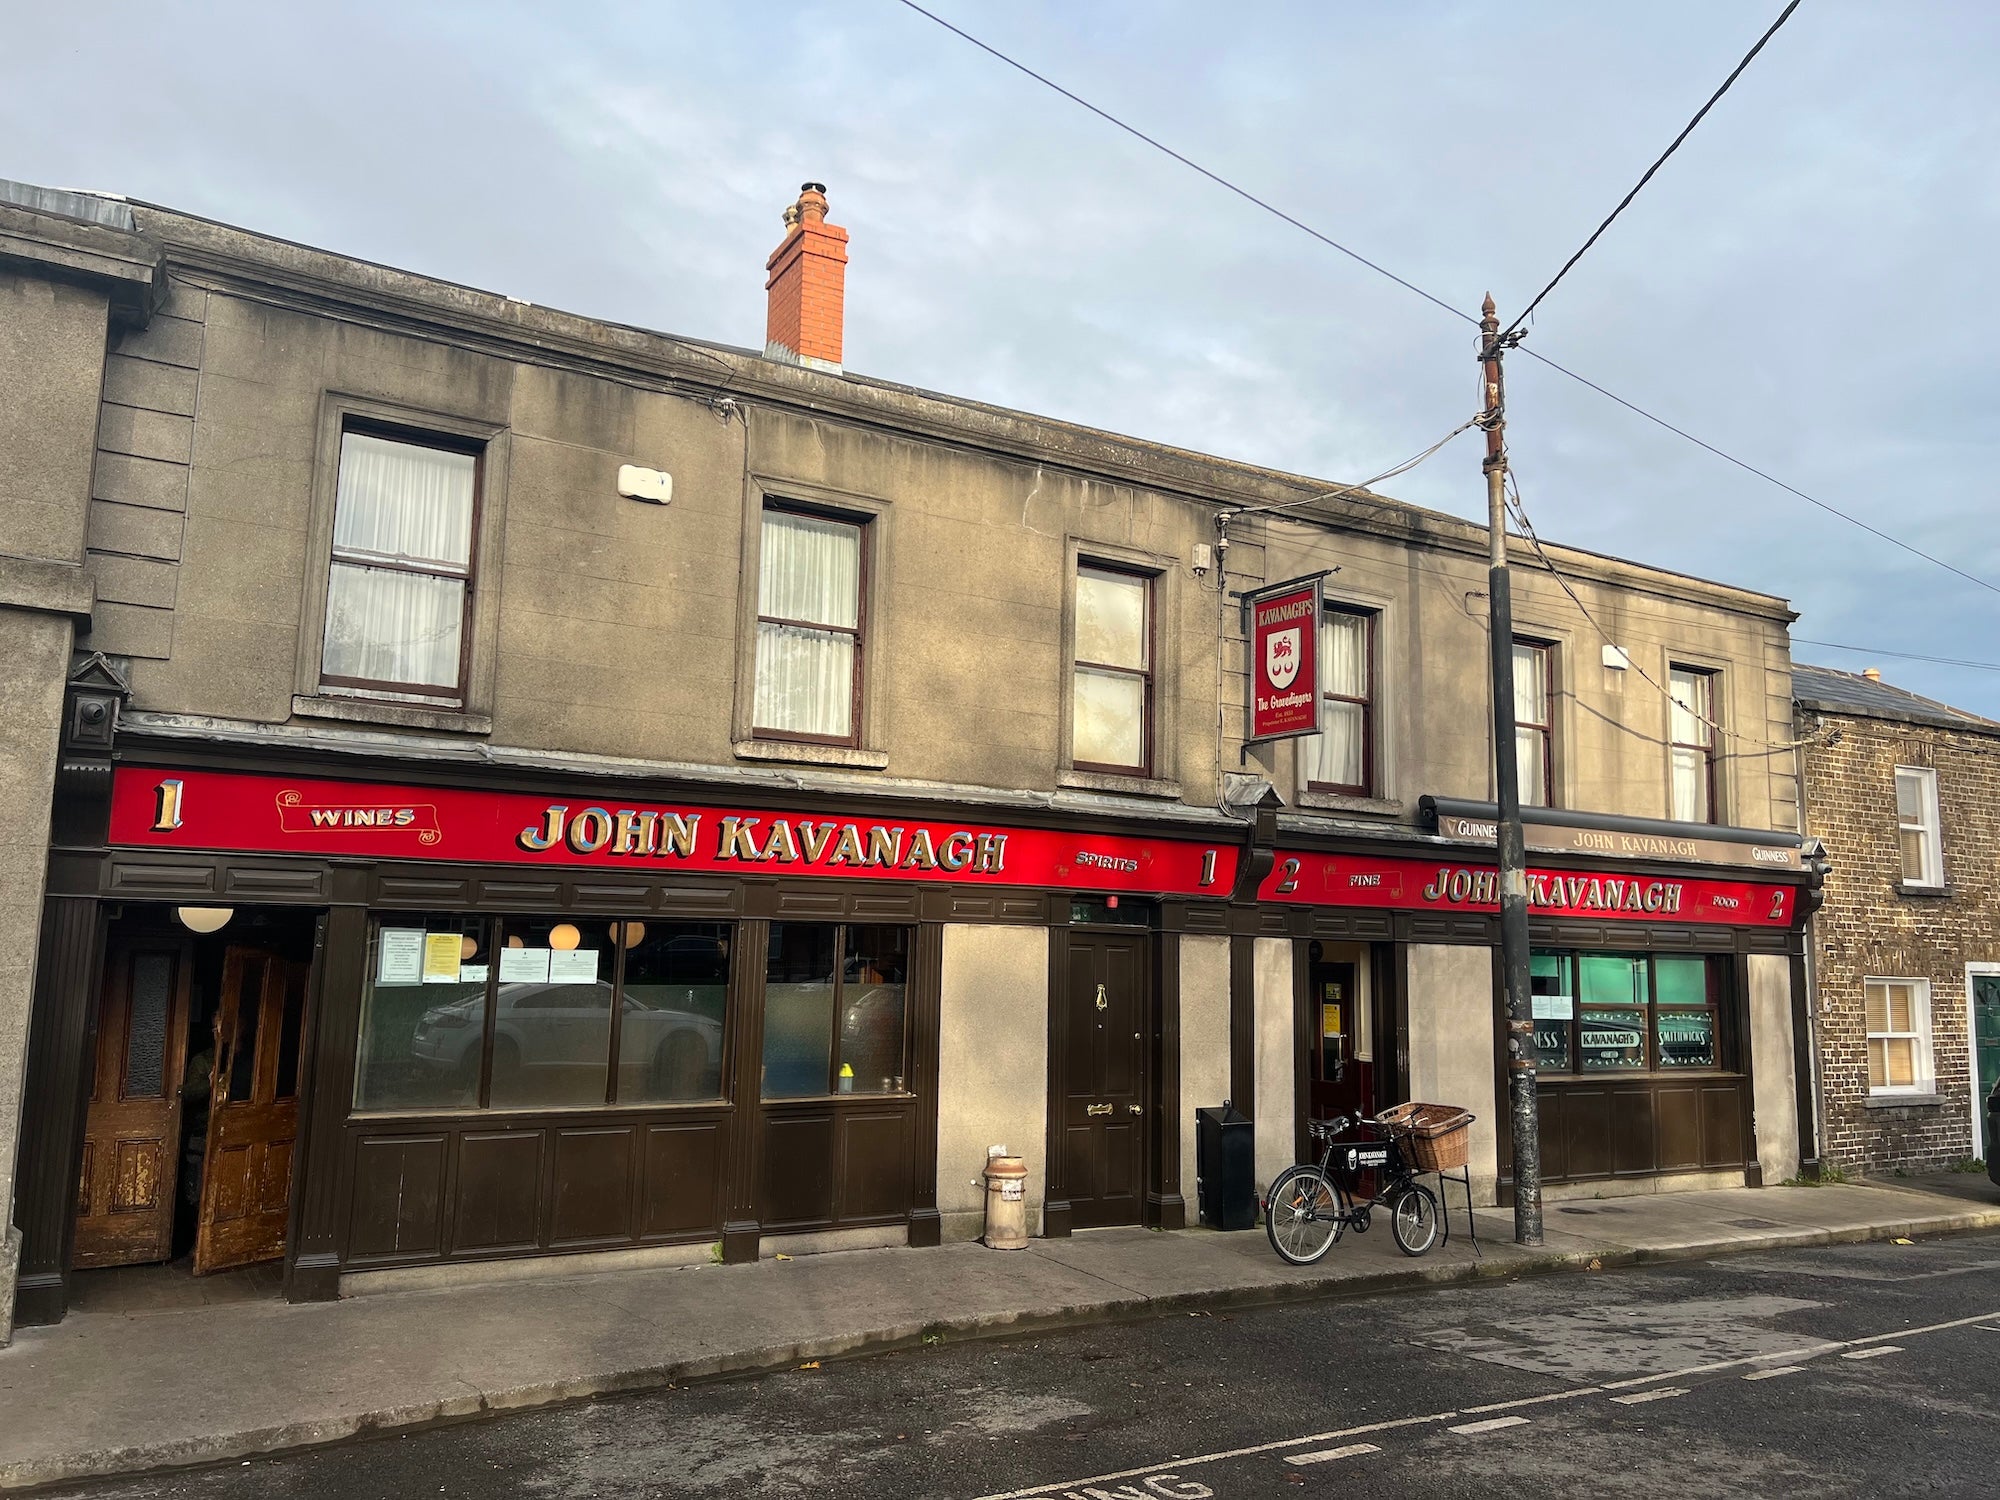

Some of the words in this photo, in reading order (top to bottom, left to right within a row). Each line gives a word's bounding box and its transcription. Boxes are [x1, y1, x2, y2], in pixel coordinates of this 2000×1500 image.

[1259, 599, 1313, 627] KAVANAGH'S
[1258, 698, 1269, 711] The
[1270, 692, 1313, 709] Gravediggers
[149, 779, 184, 833] 1
[310, 808, 415, 828] WINES
[515, 805, 702, 857] JOHN
[713, 816, 1009, 875] KAVANAGH
[1458, 820, 1498, 839] GUINNES
[1573, 832, 1615, 849] JOHN
[1621, 836, 1697, 856] KAVANAGH
[1752, 847, 1789, 863] GUINNESS
[1076, 851, 1138, 872] SPIRITS
[1198, 850, 1217, 886] 1
[1275, 857, 1301, 894] 2
[1349, 874, 1381, 887] FINE
[1526, 874, 1682, 914] KAVANAGH
[1712, 895, 1739, 908] FOOD
[1768, 890, 1785, 919] 2
